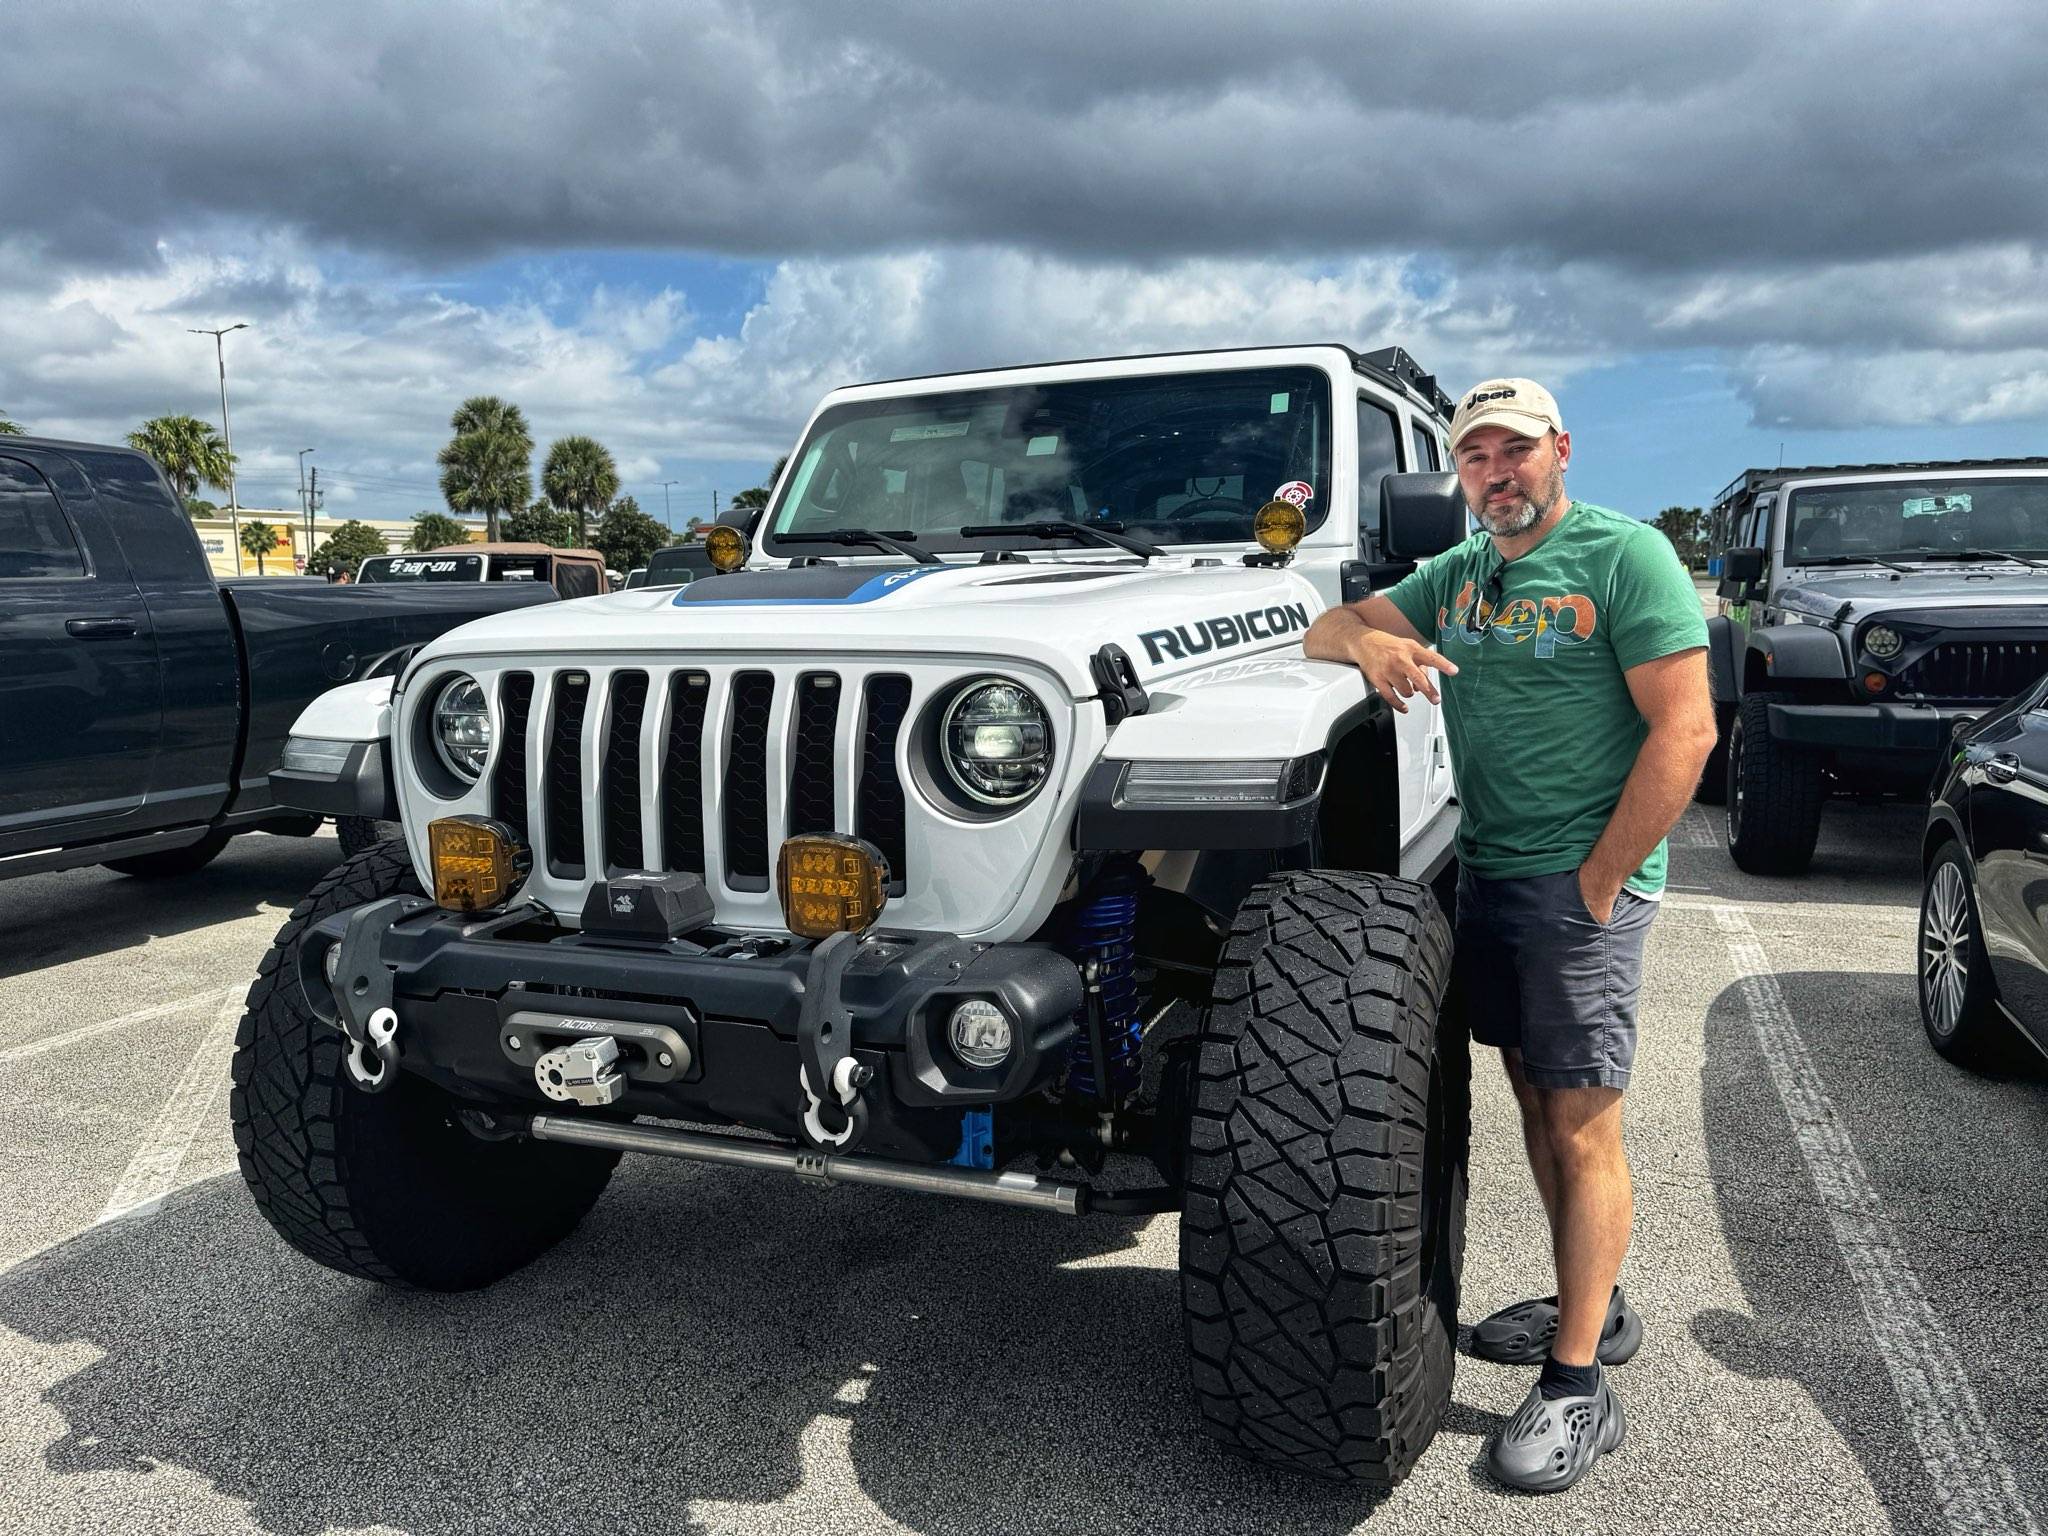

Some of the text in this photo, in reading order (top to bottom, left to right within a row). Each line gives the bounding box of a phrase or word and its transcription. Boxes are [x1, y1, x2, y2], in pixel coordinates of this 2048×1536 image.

[1467, 389, 1516, 410] Jeep
[1137, 602, 1310, 666] RUBICON
[1438, 581, 1597, 659] Jeep
[558, 1019, 595, 1031] FACTOR
